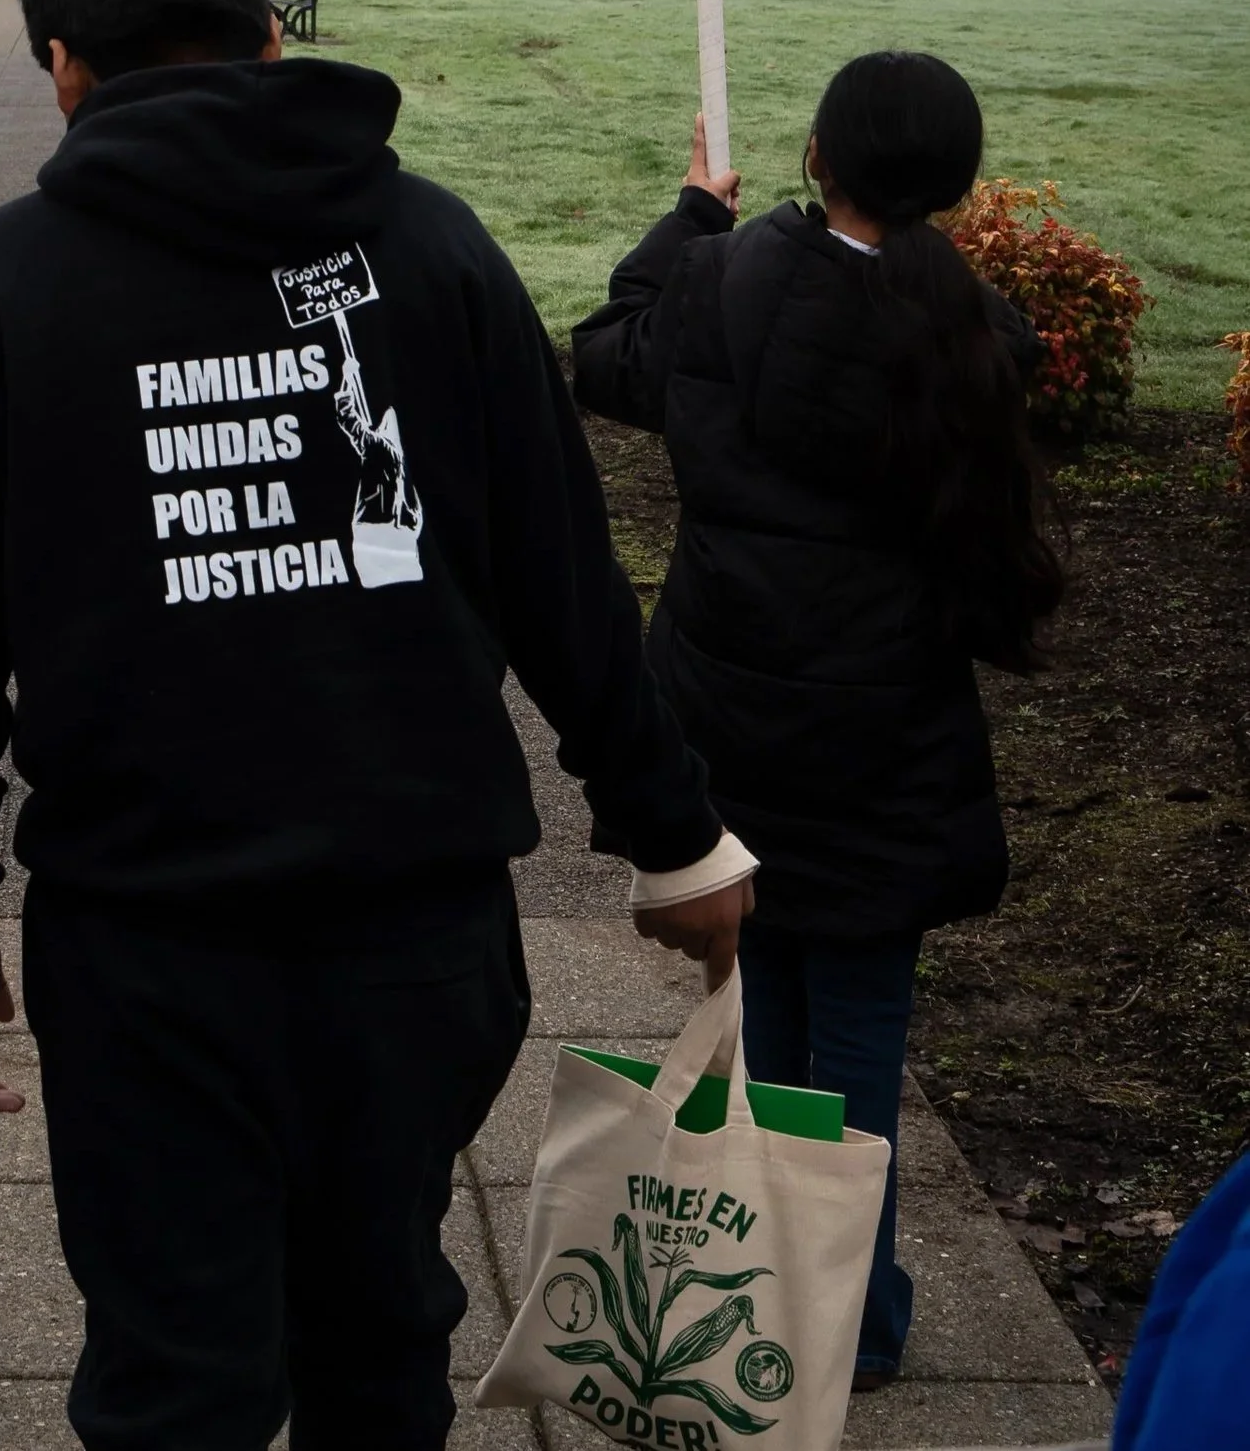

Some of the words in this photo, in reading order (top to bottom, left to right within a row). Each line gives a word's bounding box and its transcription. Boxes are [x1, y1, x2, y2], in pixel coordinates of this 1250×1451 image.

[282, 251, 353, 287] Justicia
[301, 278, 345, 299] Para
[296, 285, 361, 319] Todos
[136, 345, 330, 409] FAMILIAS
[145, 414, 302, 474] UNIDAS
[152, 488, 237, 539] POR
[244, 481, 296, 529] LA
[164, 539, 349, 604] JUSTICIA
[627, 1175, 708, 1221] FIRMES
[706, 1191, 758, 1243] EN
[646, 1220, 710, 1248] NUESTRO
[569, 1374, 722, 1451] PODER!
